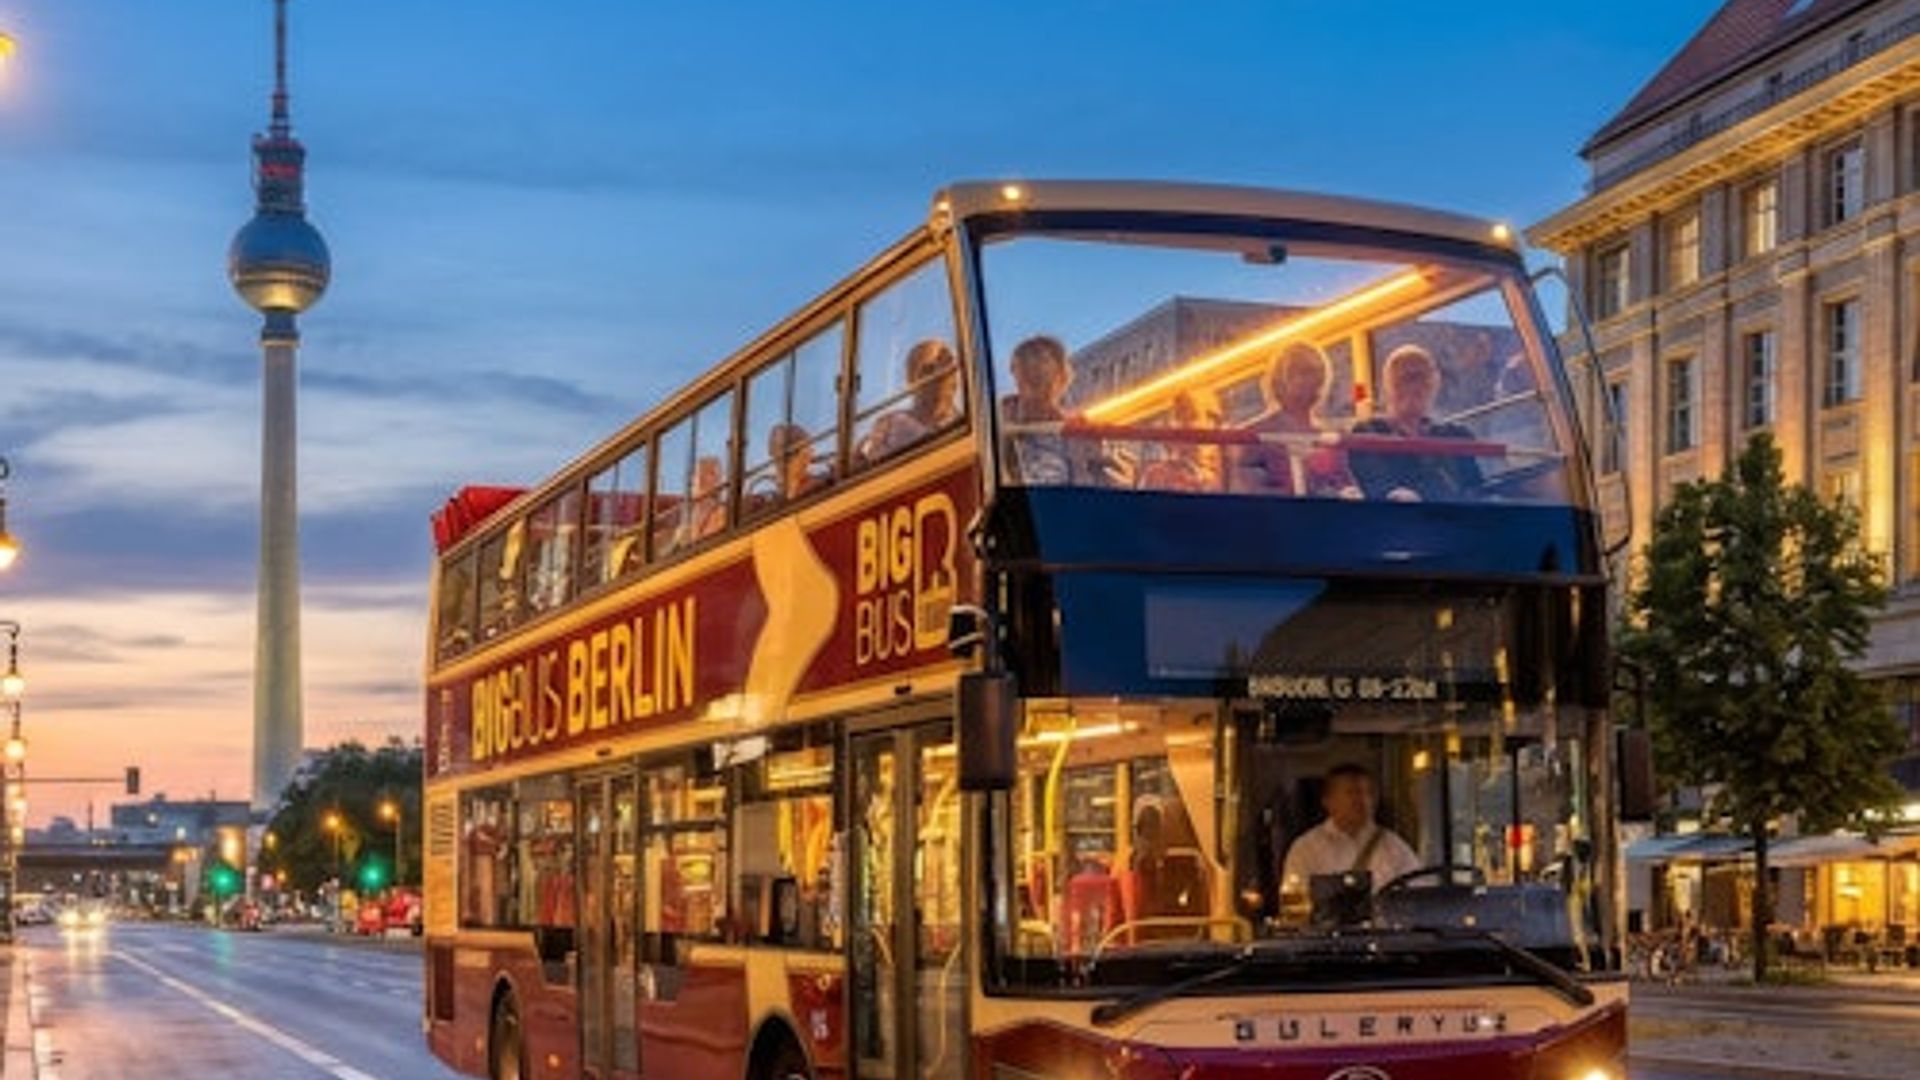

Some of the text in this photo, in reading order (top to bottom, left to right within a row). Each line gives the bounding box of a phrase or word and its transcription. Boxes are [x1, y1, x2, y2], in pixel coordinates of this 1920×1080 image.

[856, 506, 912, 595] BIG
[568, 597, 696, 736] BERLIN
[856, 589, 911, 665] BUS
